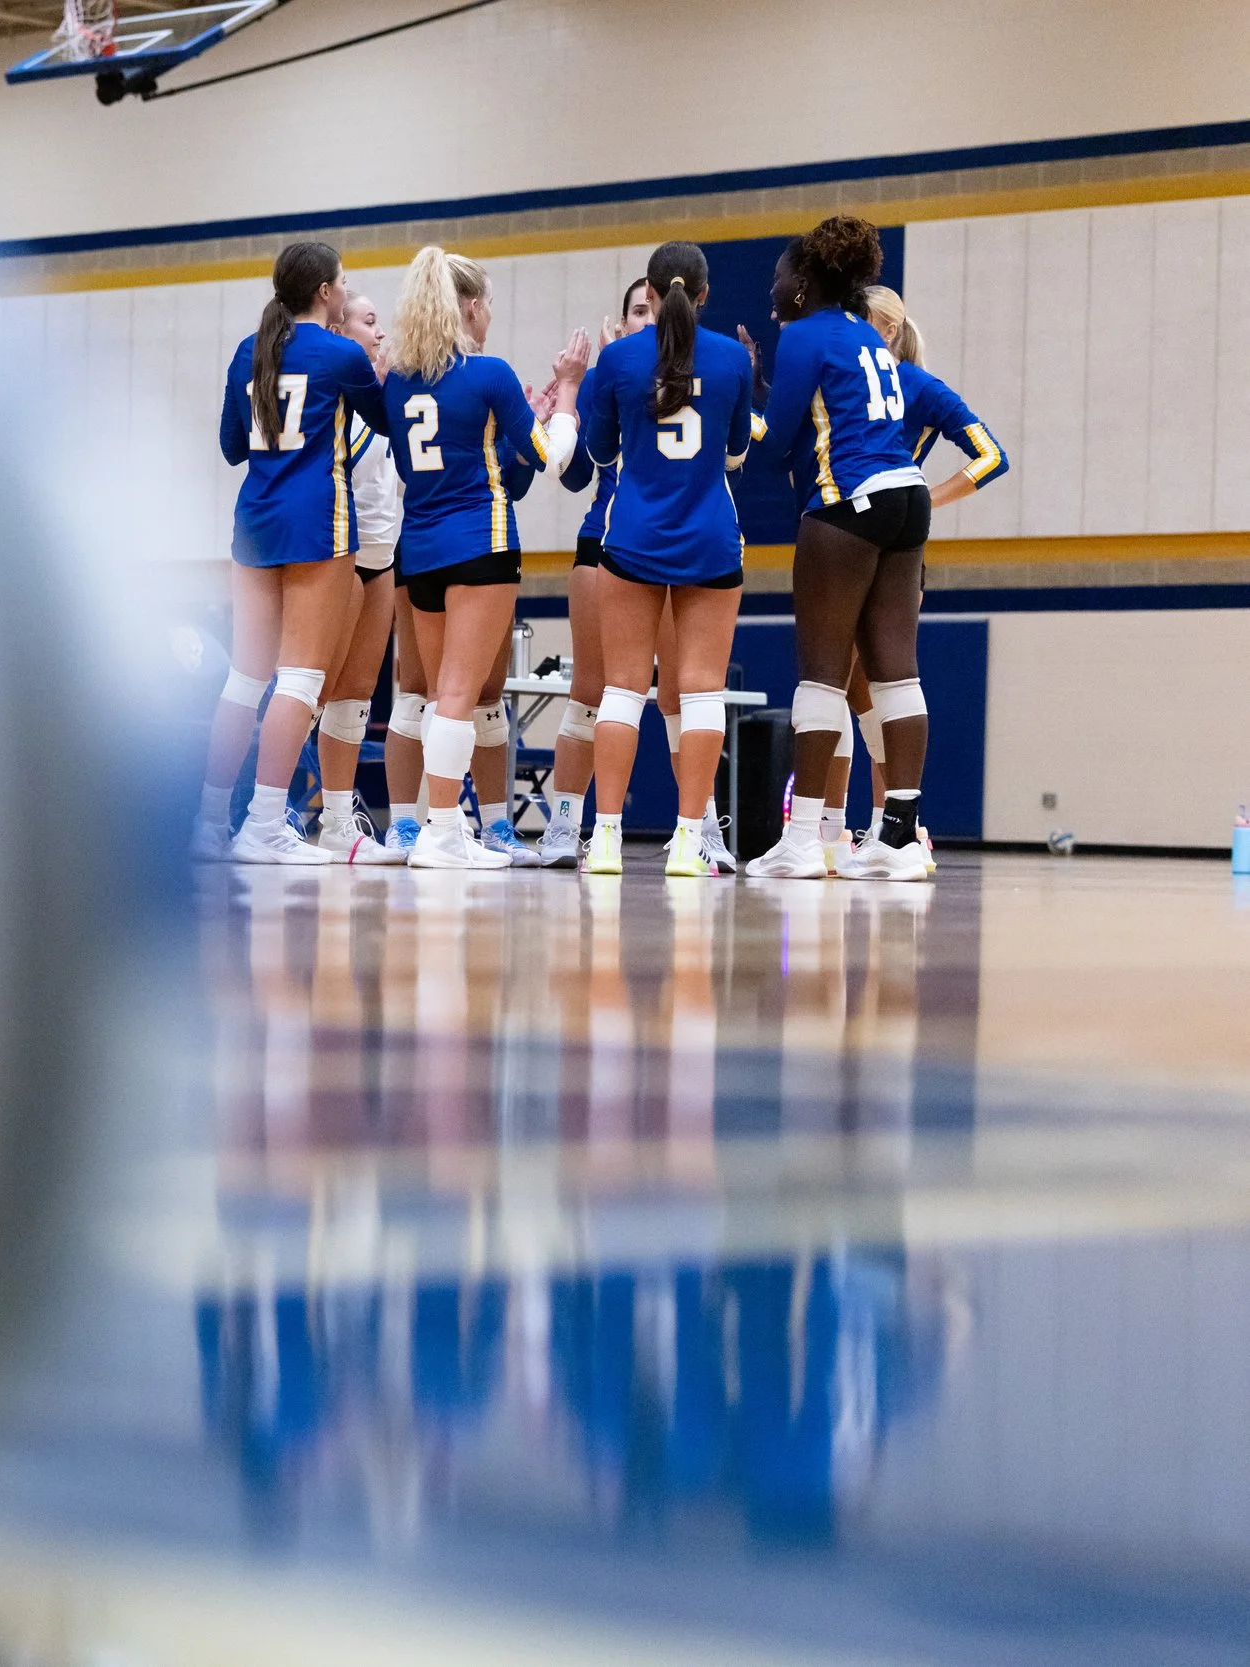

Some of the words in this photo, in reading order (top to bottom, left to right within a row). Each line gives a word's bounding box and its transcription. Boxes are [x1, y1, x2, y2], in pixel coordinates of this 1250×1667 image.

[656, 378, 702, 460] 5
[858, 345, 905, 421] 13
[403, 394, 445, 471] 2
